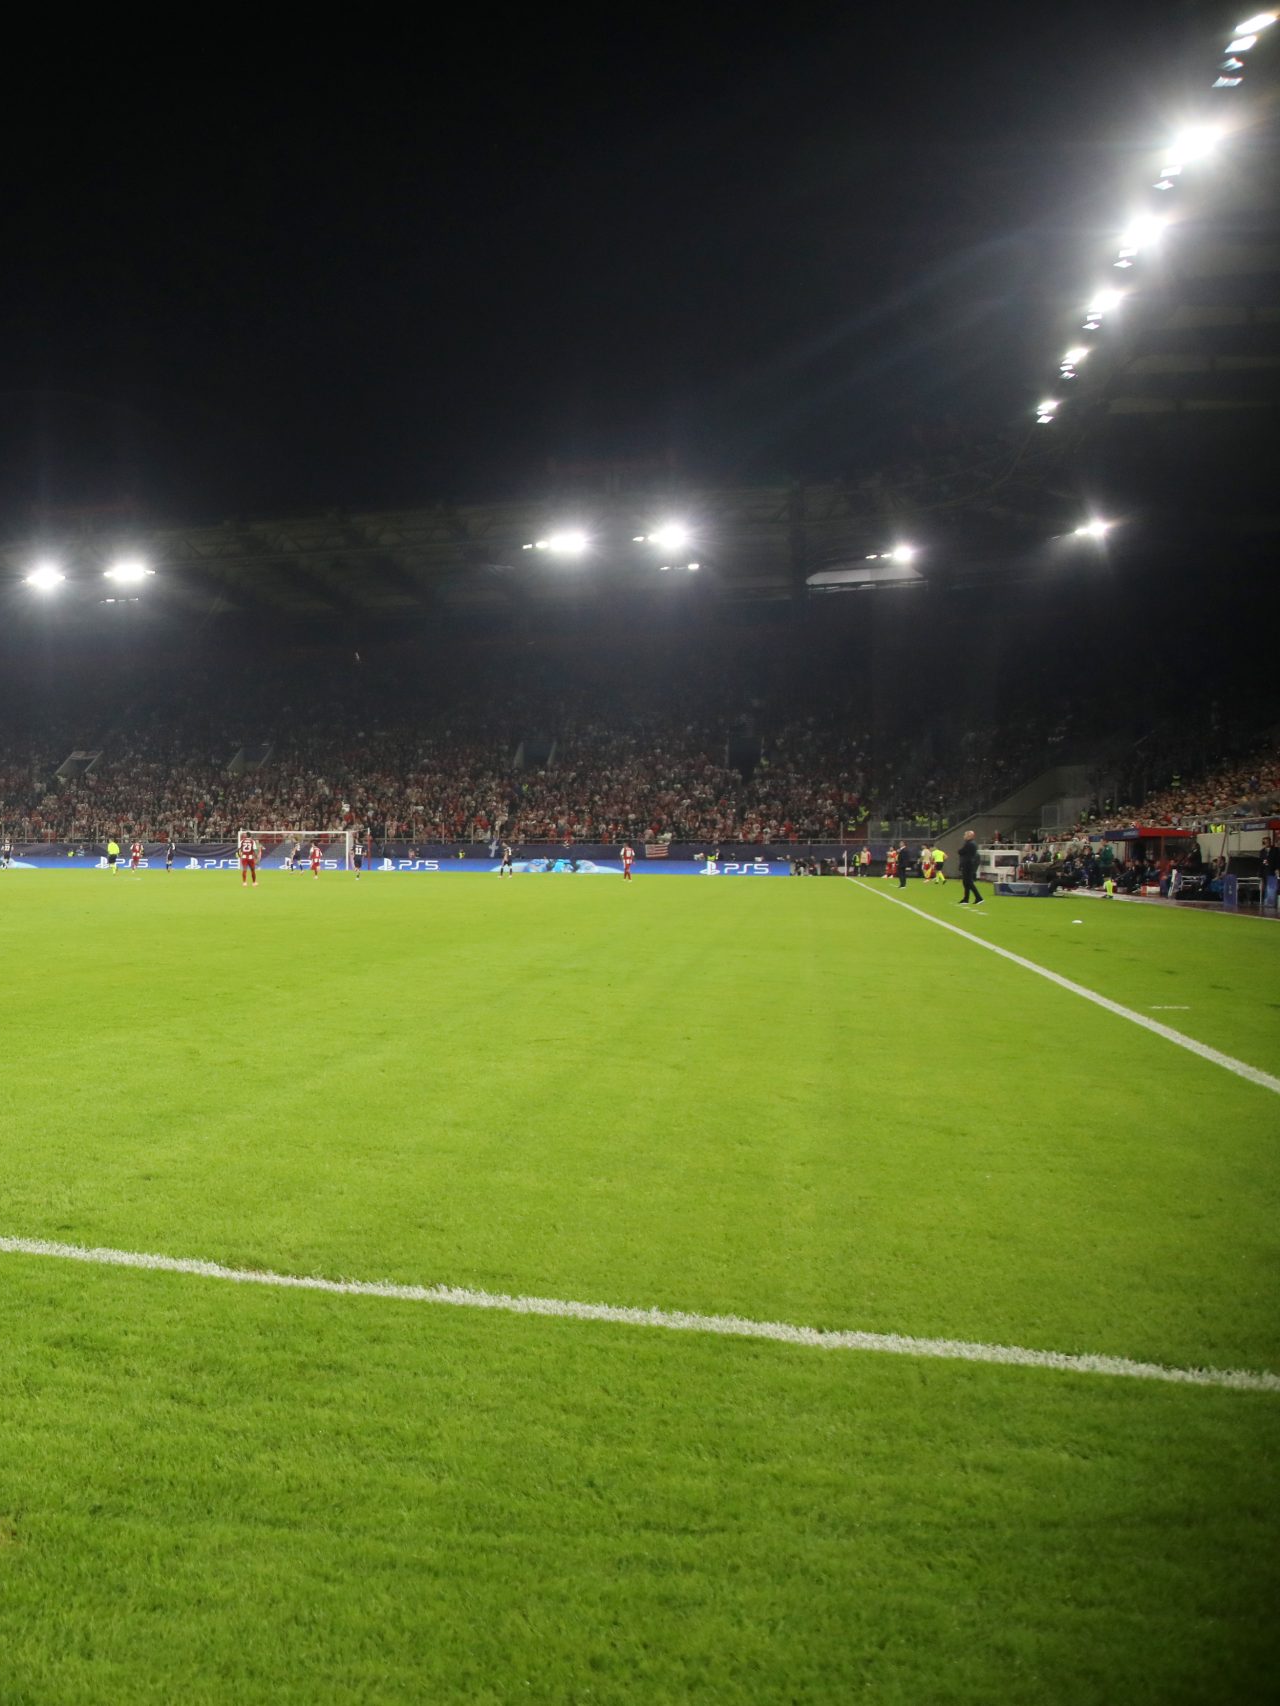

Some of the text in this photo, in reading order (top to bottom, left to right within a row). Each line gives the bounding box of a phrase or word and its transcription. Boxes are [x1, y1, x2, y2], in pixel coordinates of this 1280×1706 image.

[242, 843, 252, 852] 23
[204, 860, 240, 869] PS5
[399, 860, 439, 870] PS5
[723, 863, 770, 873] PS5
